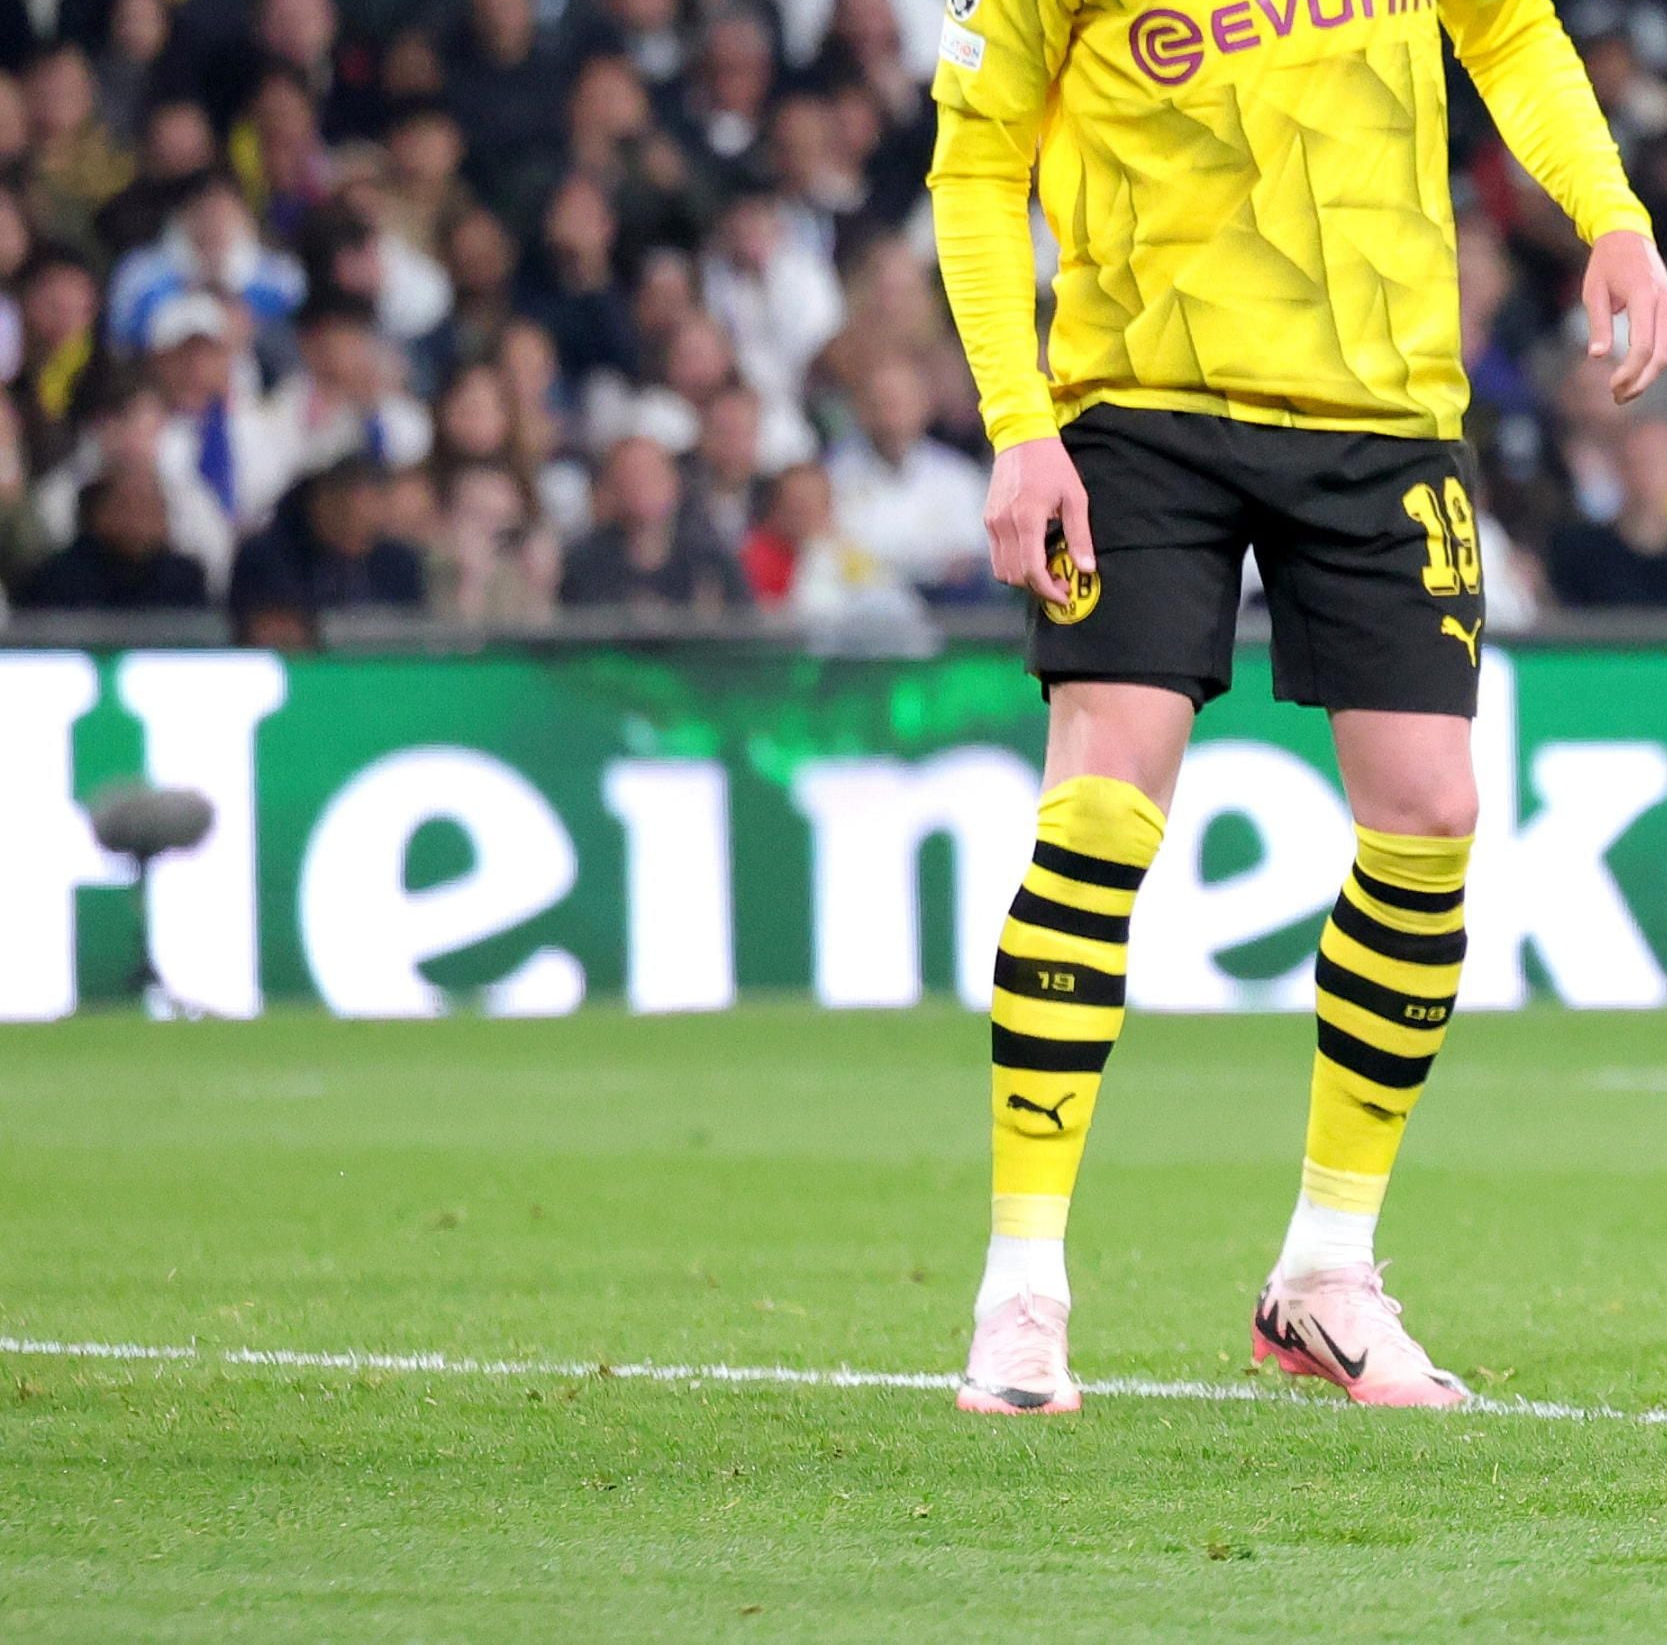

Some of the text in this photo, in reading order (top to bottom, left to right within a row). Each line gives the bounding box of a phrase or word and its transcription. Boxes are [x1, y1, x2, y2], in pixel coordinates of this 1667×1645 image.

[1402, 476, 1482, 597] 19
[1037, 970, 1076, 993] 19
[1403, 1003, 1448, 1022] 09
